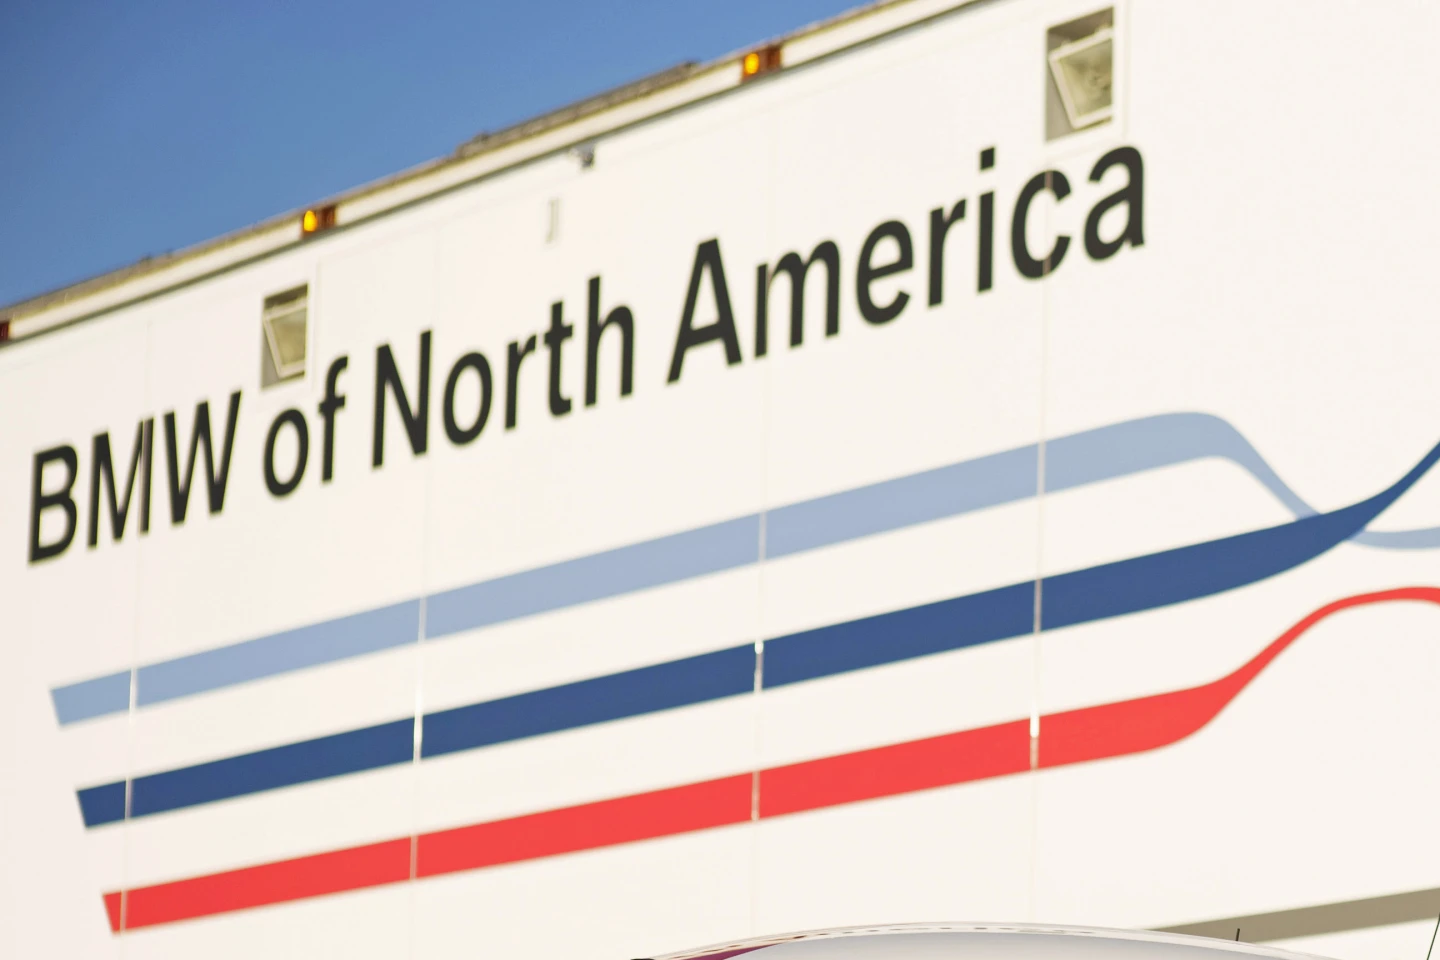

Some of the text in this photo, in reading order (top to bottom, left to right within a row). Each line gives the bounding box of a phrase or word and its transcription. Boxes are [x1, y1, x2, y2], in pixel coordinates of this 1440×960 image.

[28, 144, 1147, 566] BMW of North America
